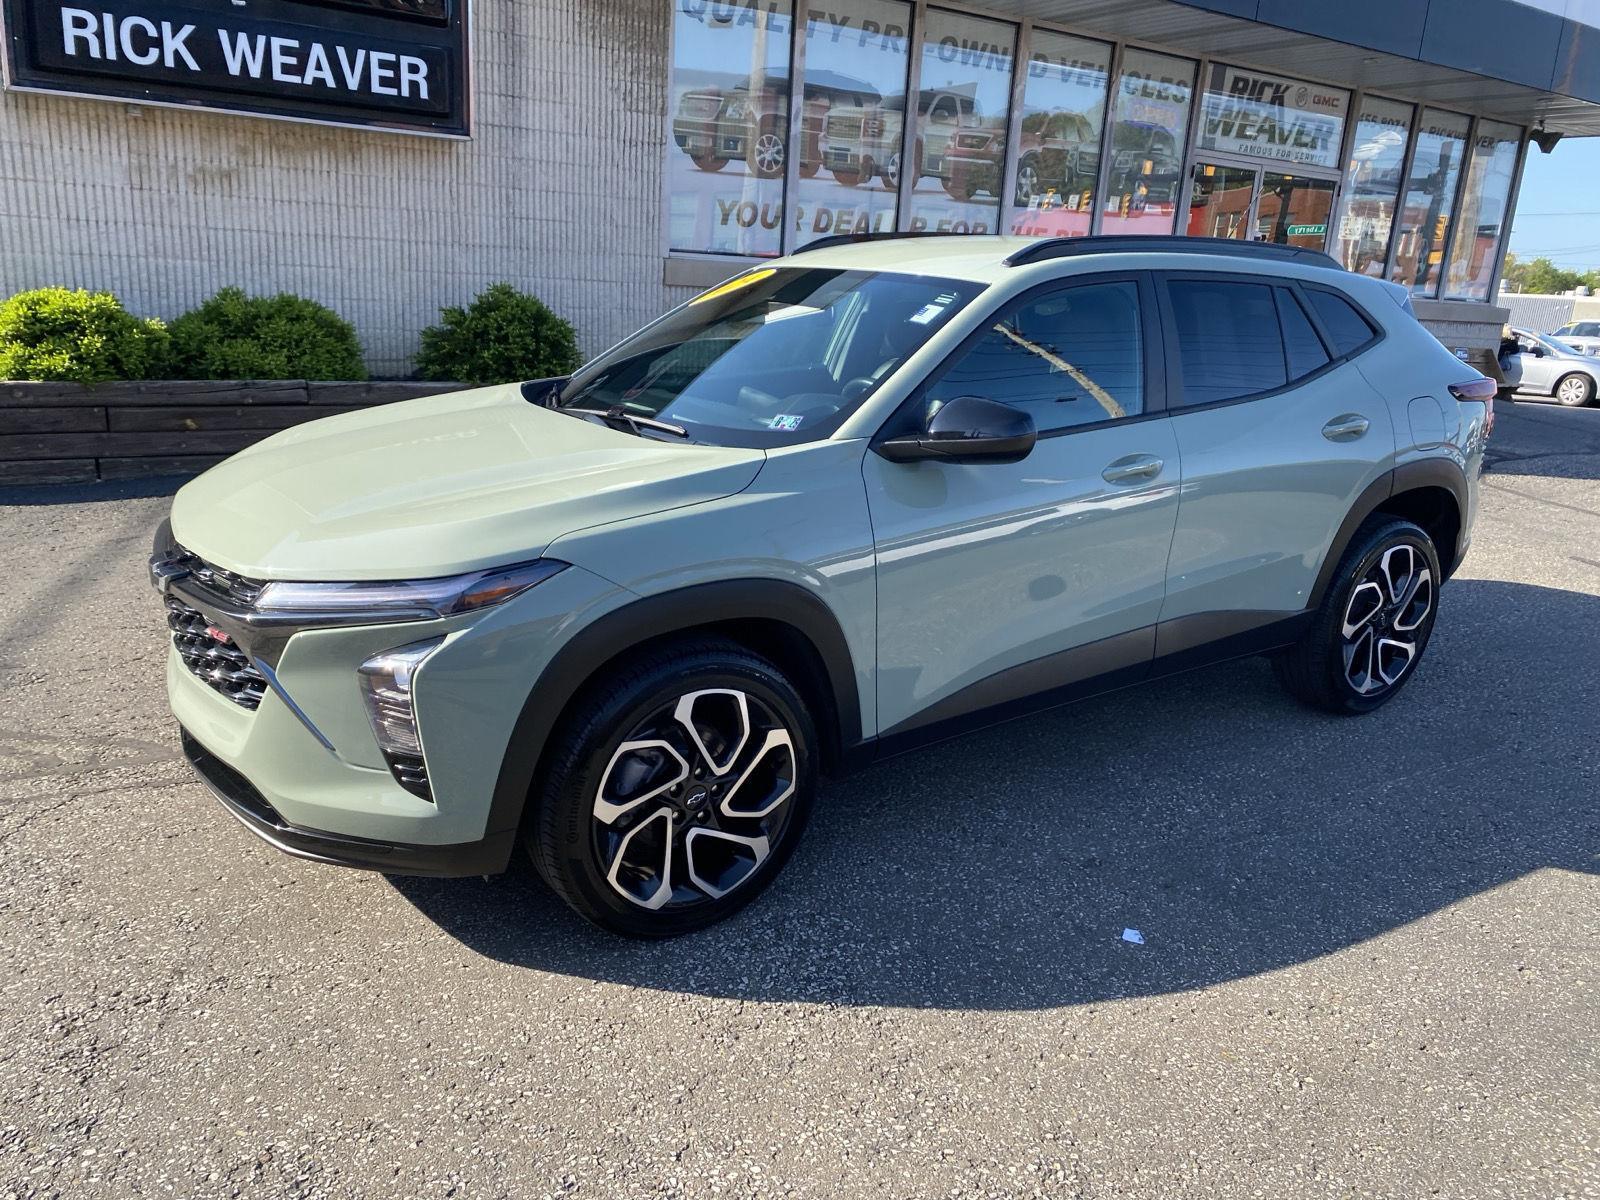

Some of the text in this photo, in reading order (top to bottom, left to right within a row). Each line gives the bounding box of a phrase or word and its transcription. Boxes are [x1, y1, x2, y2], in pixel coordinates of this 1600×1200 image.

[61, 6, 429, 100] RICK WEAVER
[682, 0, 851, 43] QUALTY
[1059, 57, 1189, 104] VEHCLES
[1227, 76, 1293, 115] RICK
[1312, 94, 1340, 108] GMC
[1206, 104, 1336, 151] WEAVER
